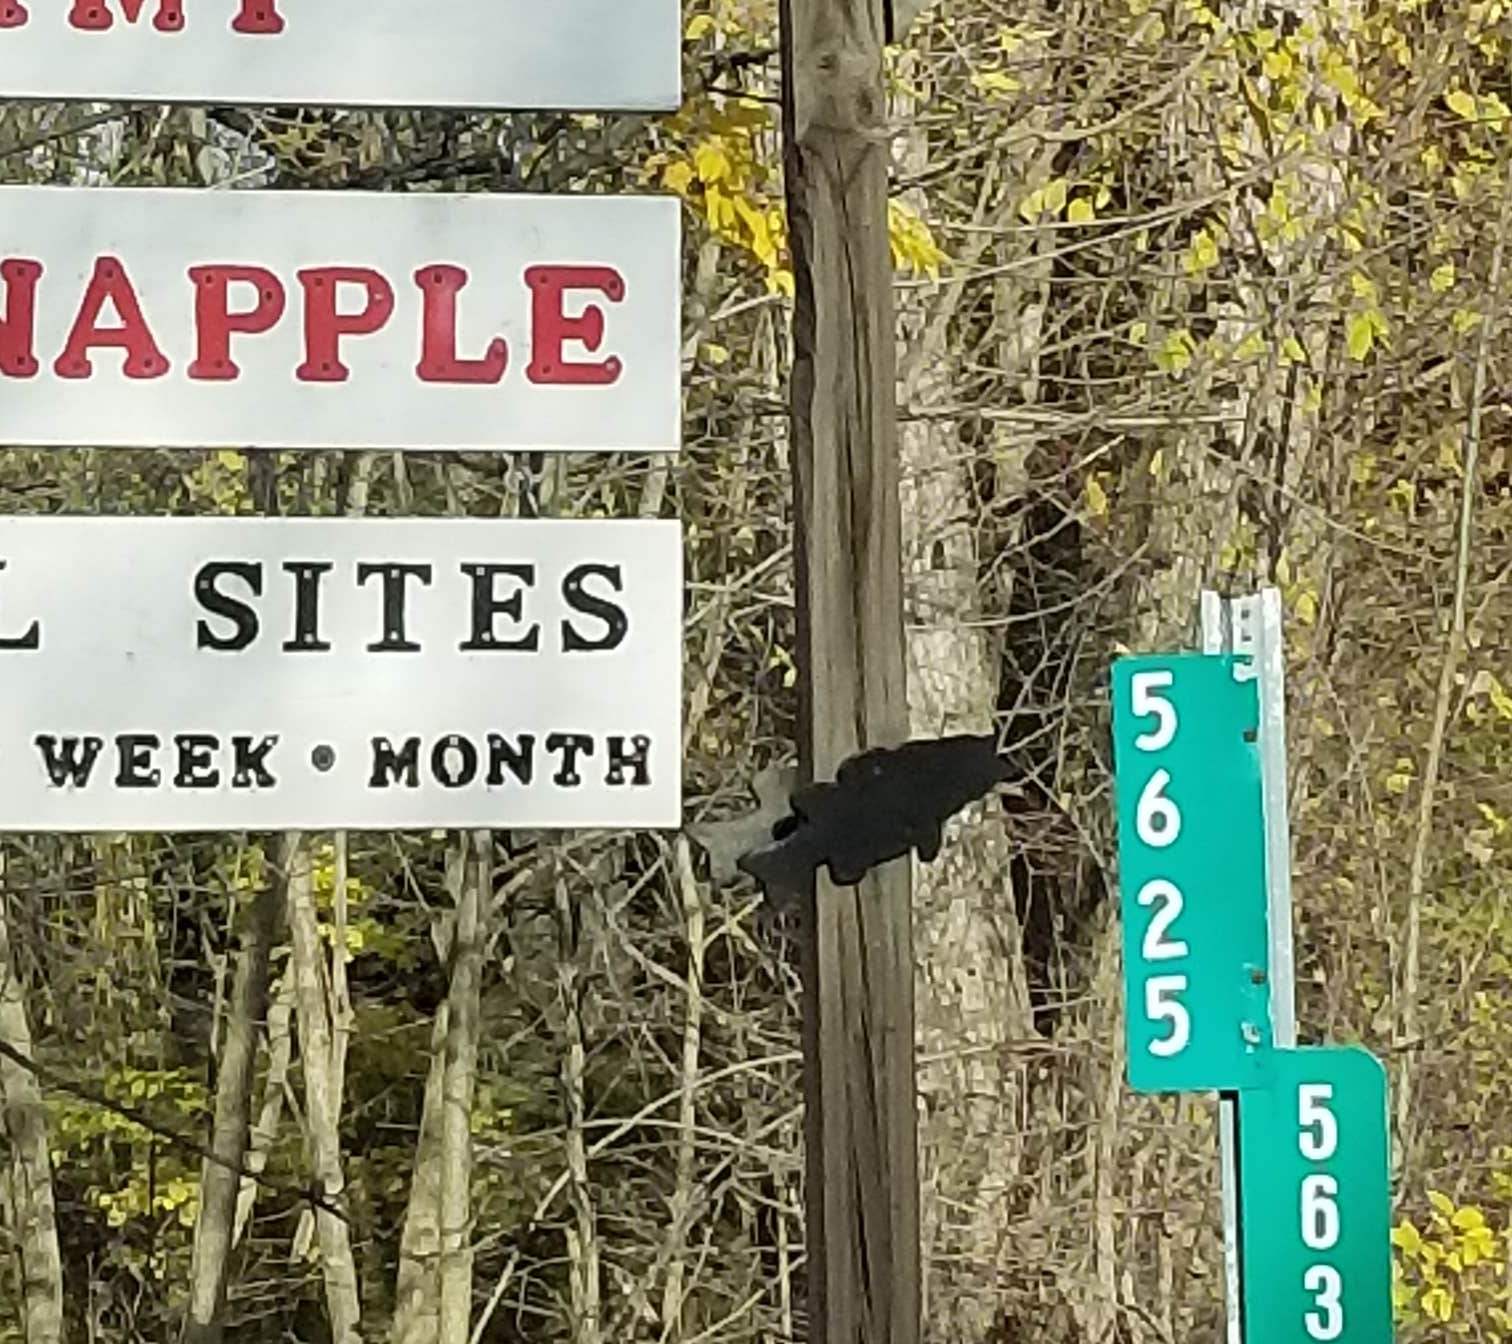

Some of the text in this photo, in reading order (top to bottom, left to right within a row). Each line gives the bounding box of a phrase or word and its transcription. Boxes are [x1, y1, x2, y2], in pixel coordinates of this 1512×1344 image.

[194, 561, 629, 653] SITES
[35, 733, 279, 789] WEEK
[369, 732, 652, 788] MONTH
[1130, 670, 1190, 1059] 5625
